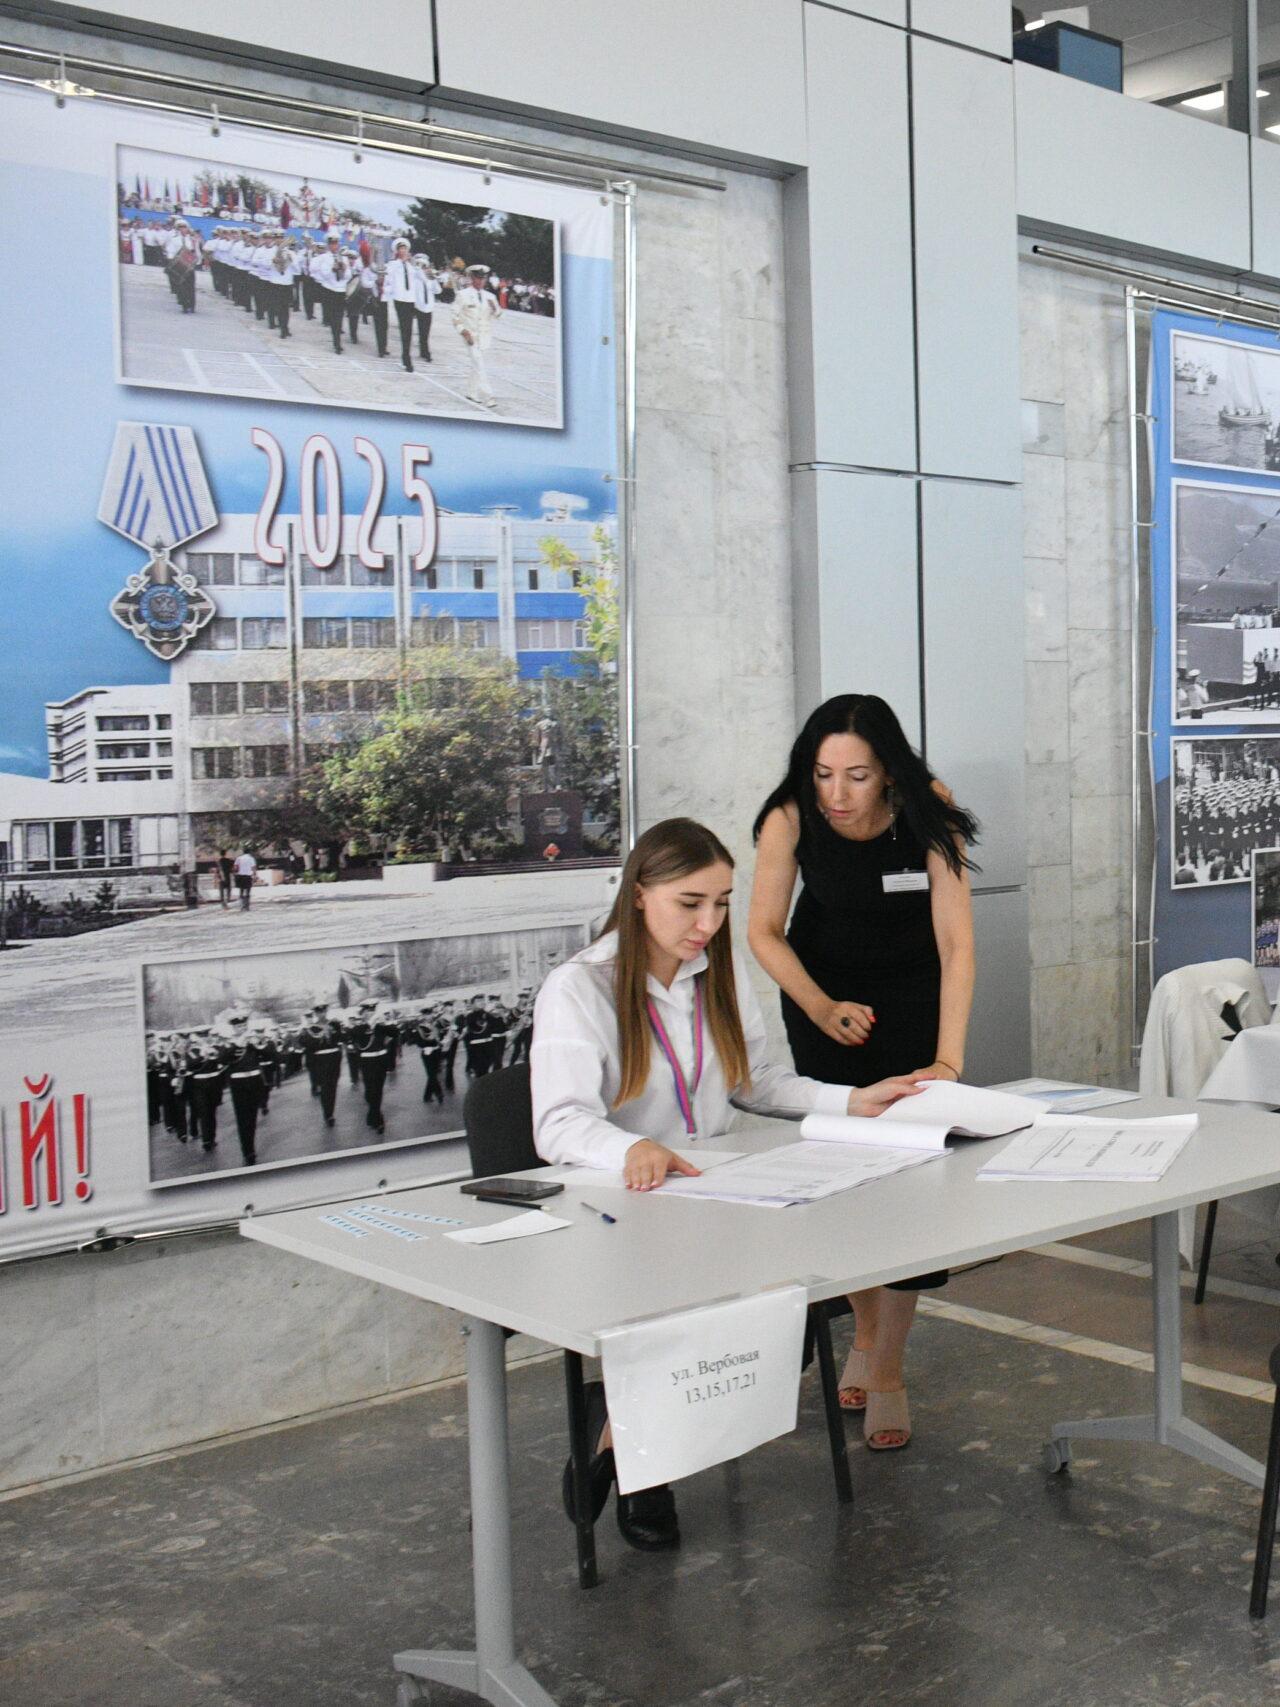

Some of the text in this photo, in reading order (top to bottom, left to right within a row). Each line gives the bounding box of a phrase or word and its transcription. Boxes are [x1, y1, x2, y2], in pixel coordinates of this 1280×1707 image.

[250, 427, 437, 570] 2025
[671, 1350, 759, 1386] ул. Вербовая
